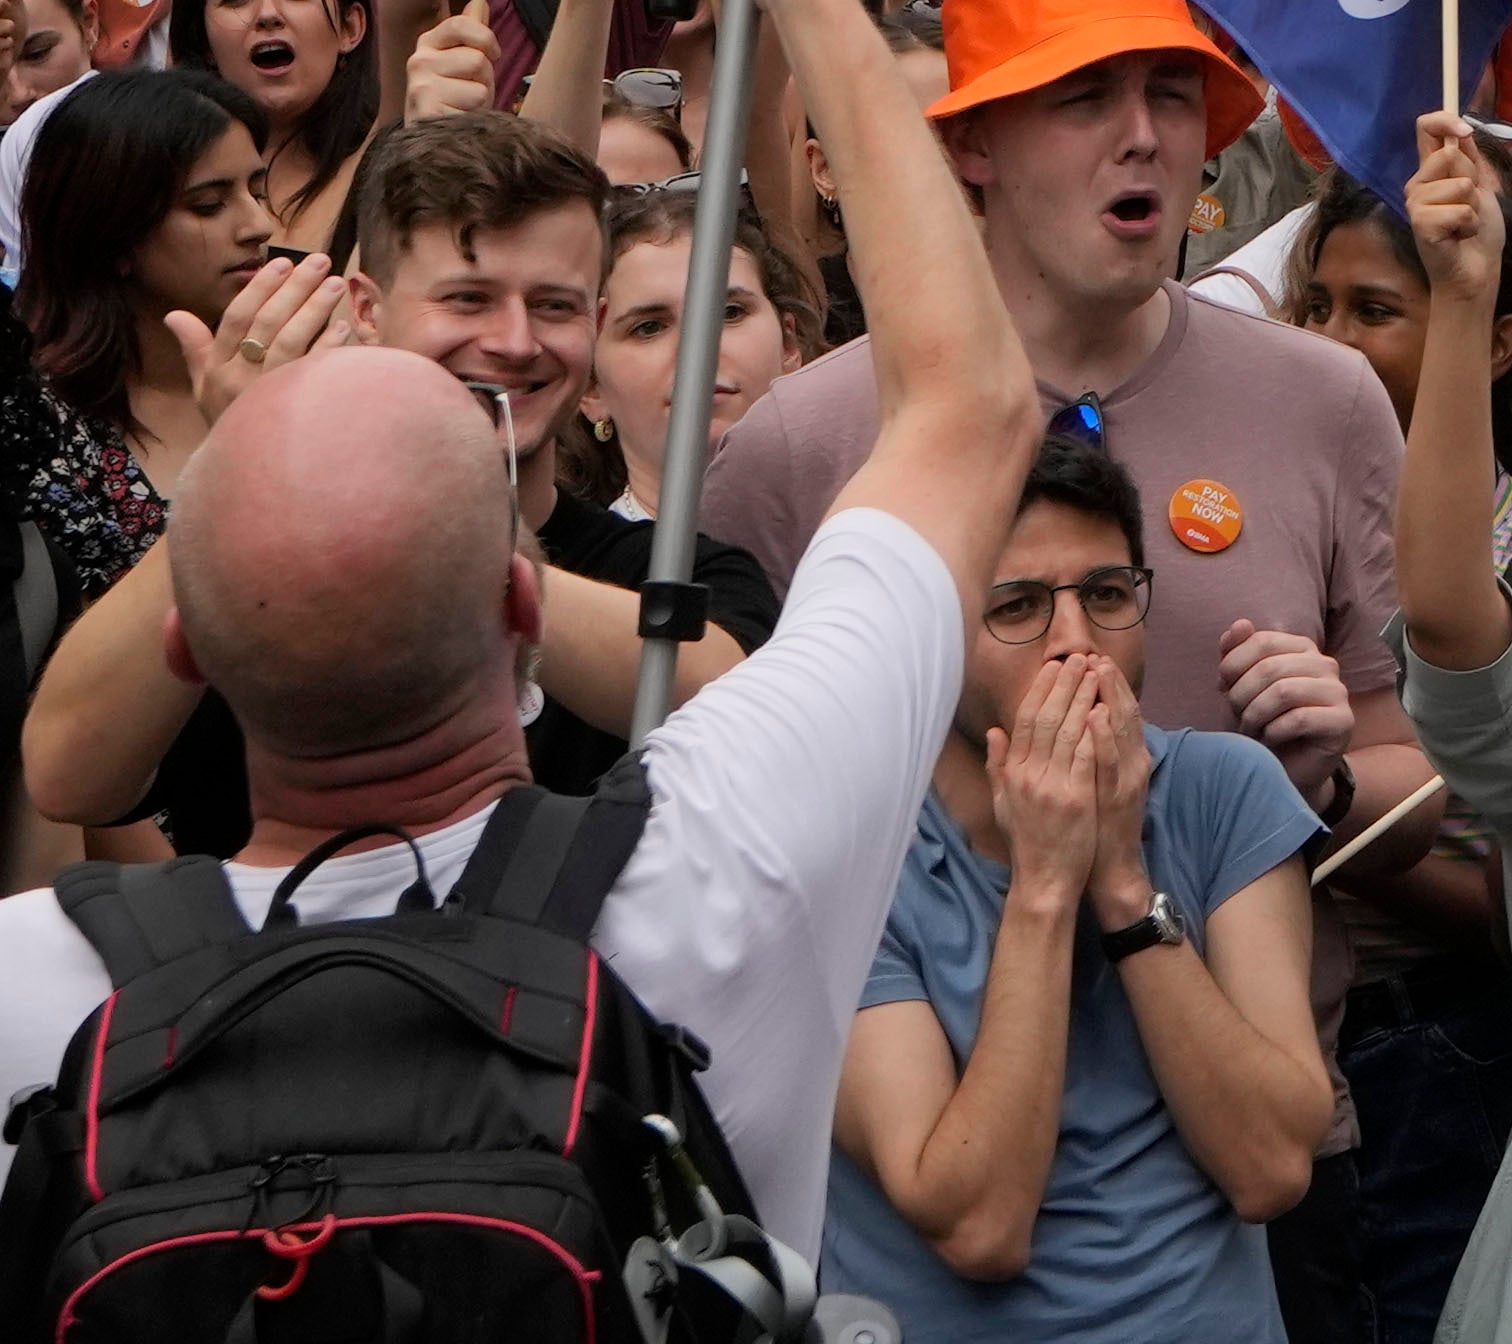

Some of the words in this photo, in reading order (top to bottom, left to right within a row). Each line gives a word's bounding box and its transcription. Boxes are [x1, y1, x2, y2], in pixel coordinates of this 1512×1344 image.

[1182, 489, 1239, 520] RESTORATION
[1202, 487, 1228, 503] PAY
[1192, 504, 1224, 523] NOW
